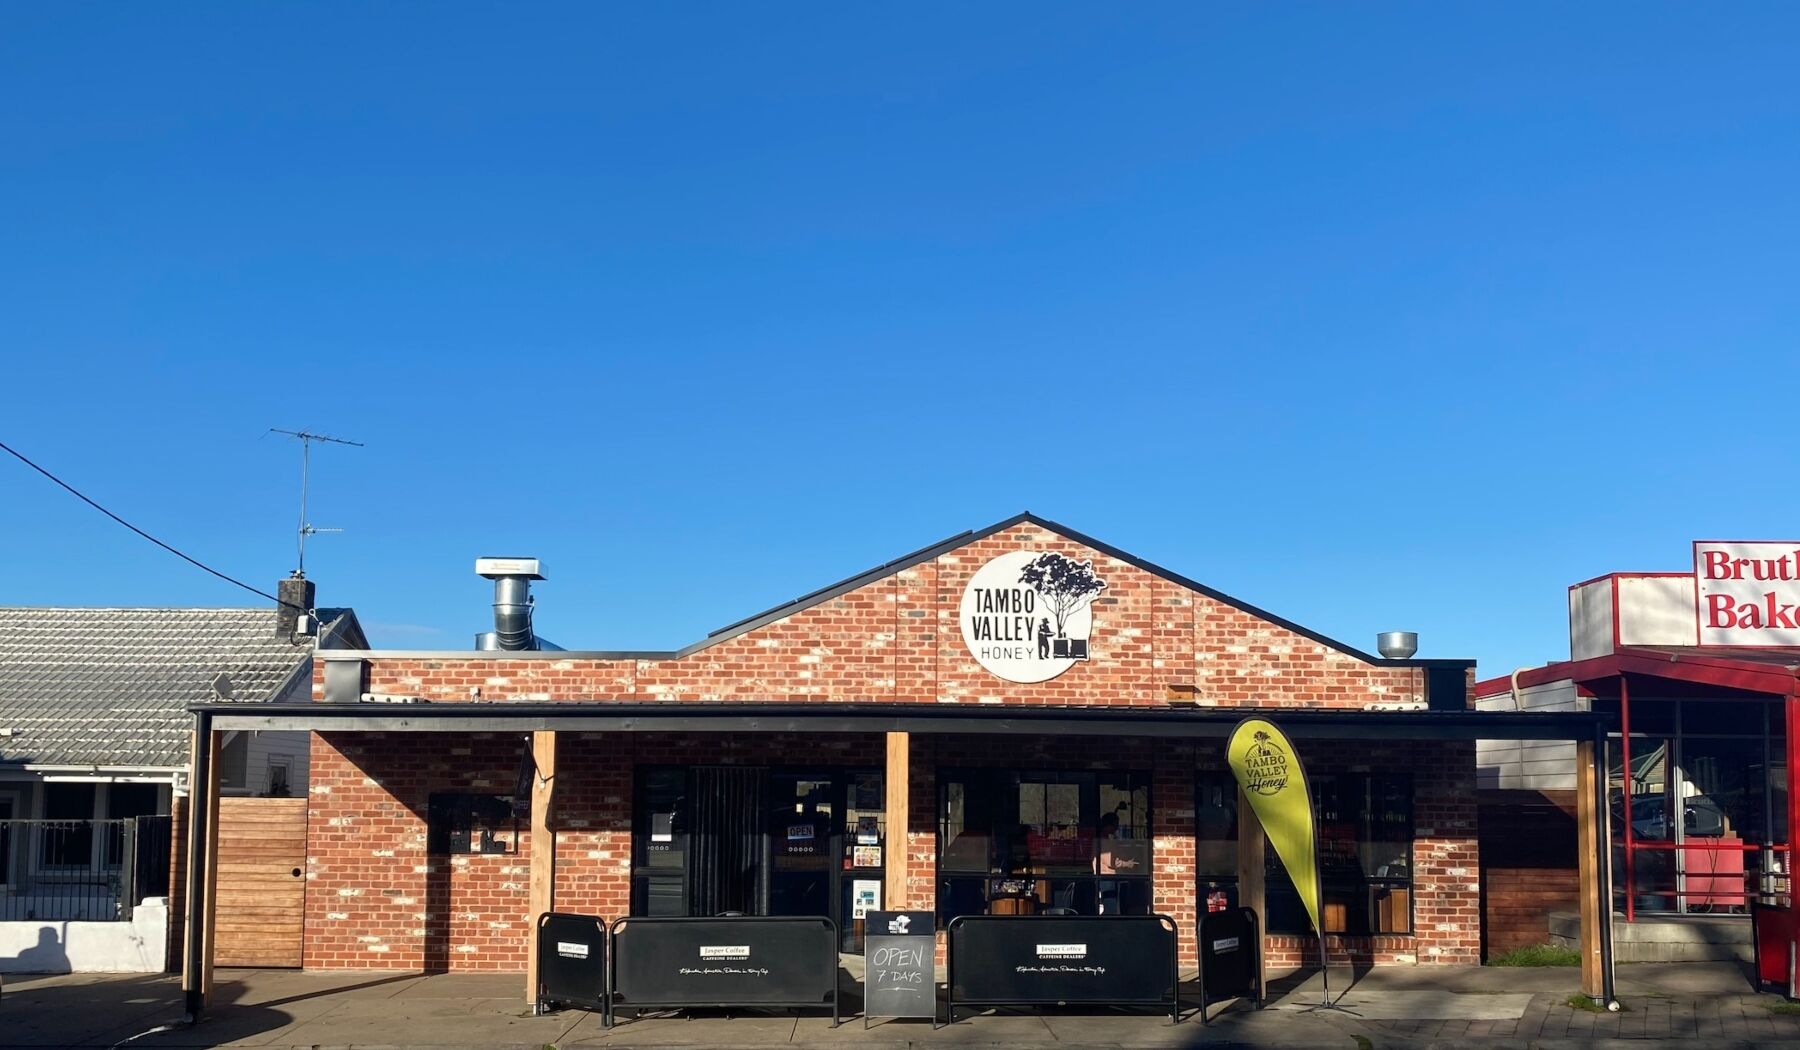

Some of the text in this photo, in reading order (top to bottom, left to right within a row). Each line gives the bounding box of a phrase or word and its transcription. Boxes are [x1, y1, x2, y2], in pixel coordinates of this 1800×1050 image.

[974, 588, 1035, 614] TAMBO
[972, 616, 1035, 641] VALLEY
[981, 646, 1034, 660] HONEY
[1245, 755, 1286, 769] TAMBO
[1246, 765, 1288, 779] VALLEY
[1247, 777, 1288, 792] Honey
[790, 825, 813, 837] OPEN
[704, 947, 724, 955] Jasper
[873, 944, 924, 968] OPEN
[876, 969, 922, 984] 7 DAYS
